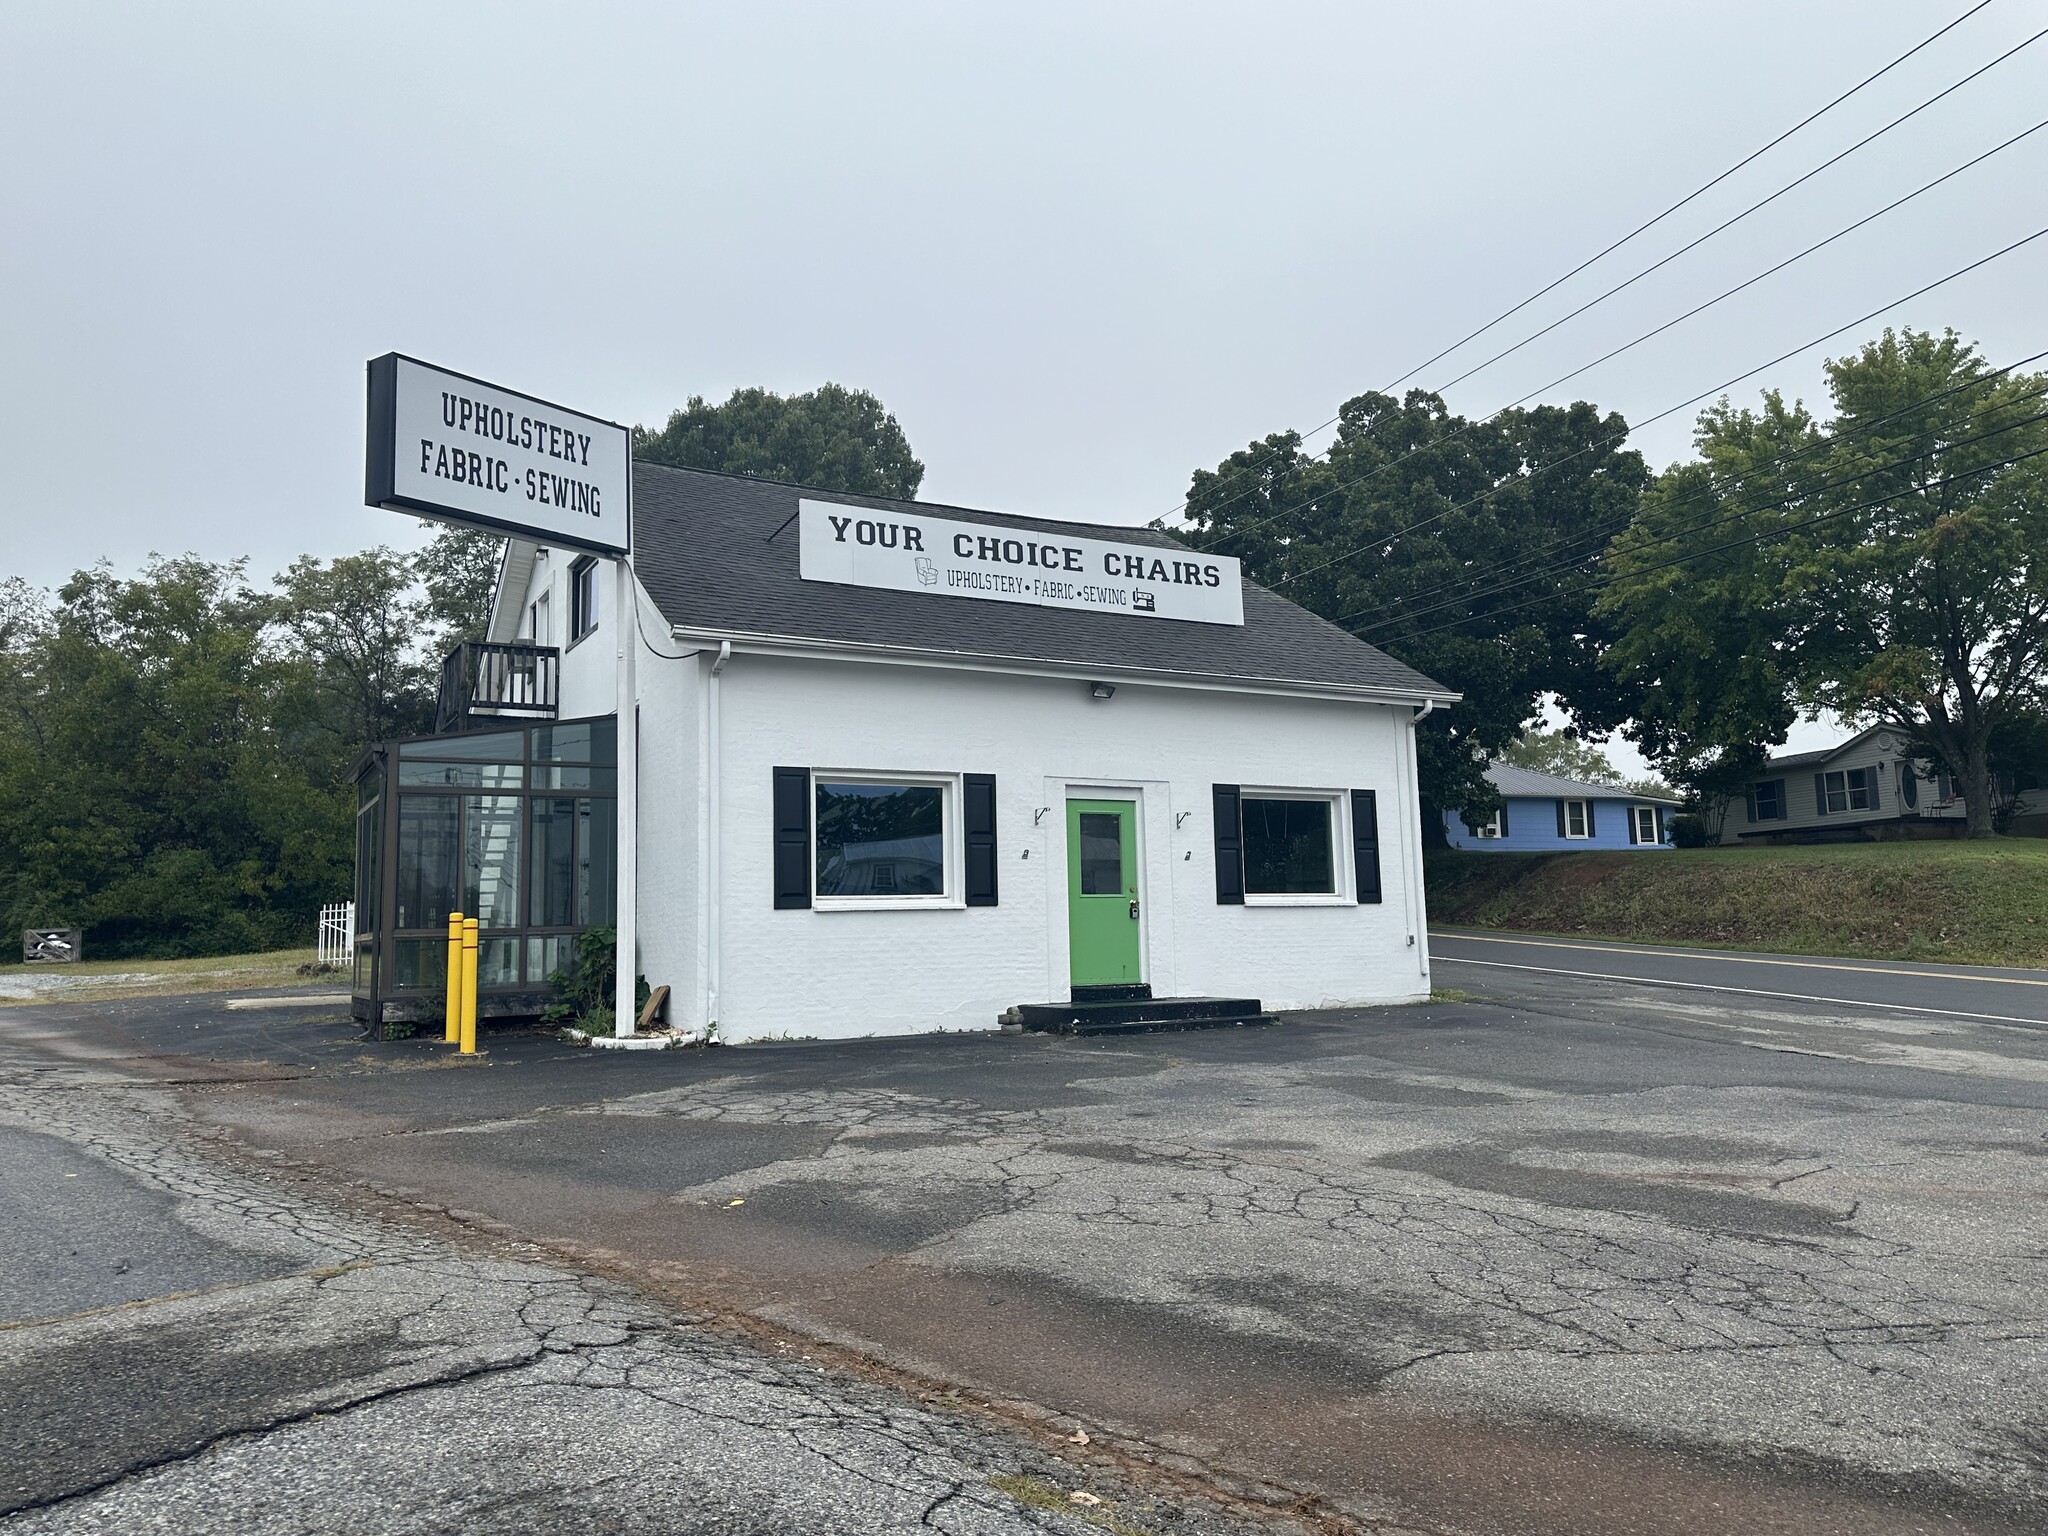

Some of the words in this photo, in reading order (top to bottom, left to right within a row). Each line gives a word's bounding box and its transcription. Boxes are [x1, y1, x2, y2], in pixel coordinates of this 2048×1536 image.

[441, 391, 591, 467] UPHOLSTERY
[420, 438, 508, 494] FABRIC
[526, 467, 601, 518] SEWING
[828, 515, 925, 552] YOUR
[953, 533, 1084, 573] CHOICE
[1103, 552, 1220, 588] CHAIRS
[946, 569, 1023, 594] UPHOLSTERY
[1034, 579, 1075, 601] FABRIC
[1083, 585, 1127, 606] SEWING
